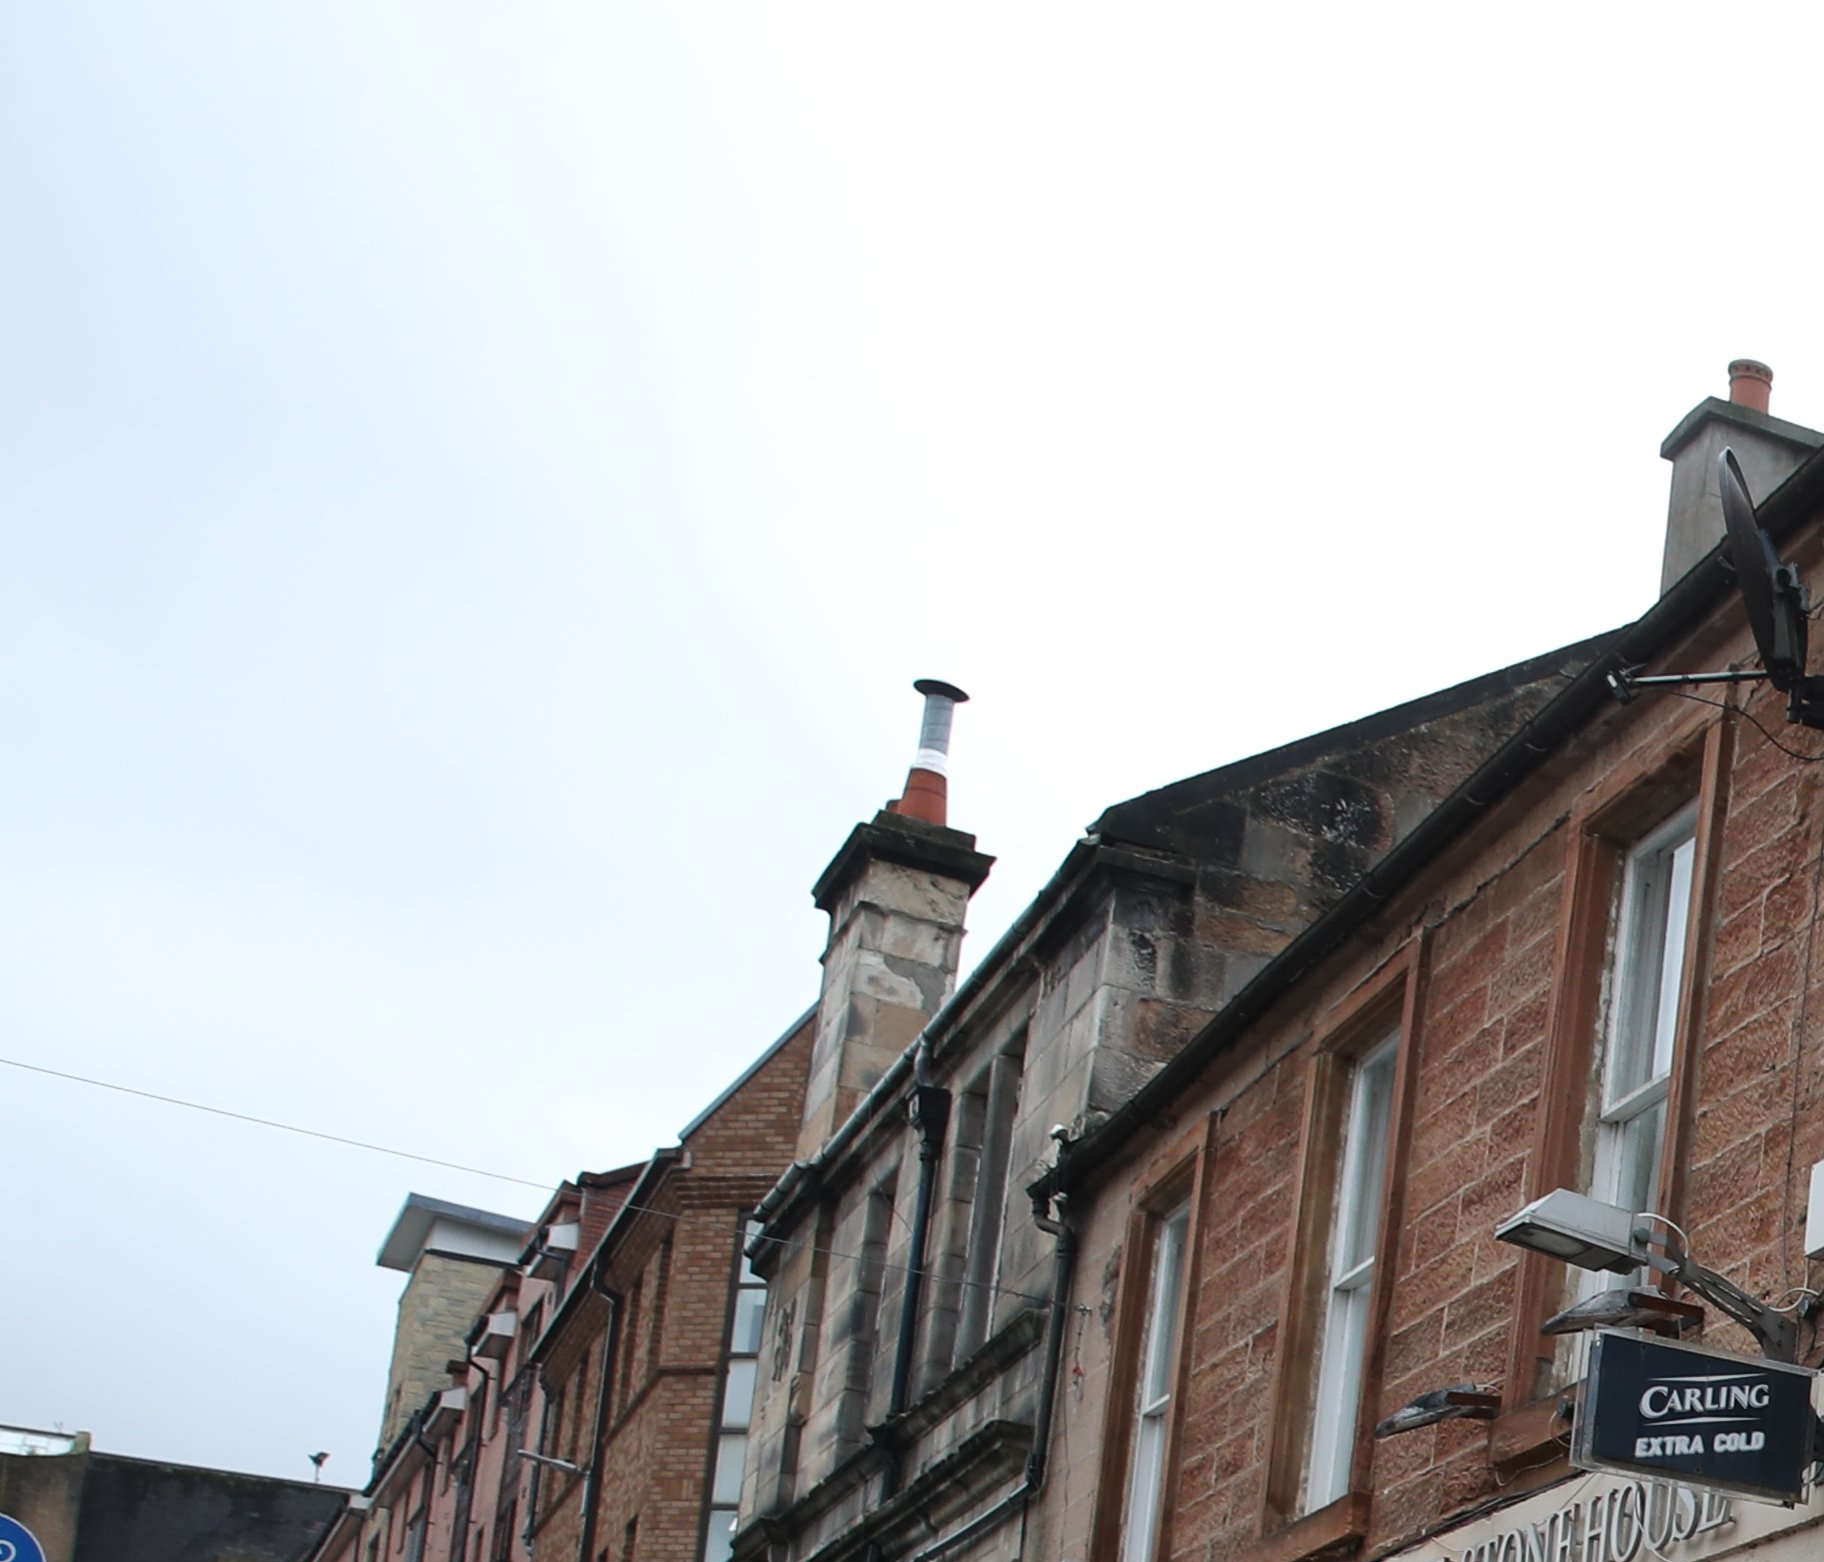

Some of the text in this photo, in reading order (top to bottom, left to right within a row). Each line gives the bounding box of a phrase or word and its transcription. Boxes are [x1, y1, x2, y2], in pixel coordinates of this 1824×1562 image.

[1639, 1384, 1770, 1419] CARLING
[1635, 1431, 1765, 1458] EXTRA COLD
